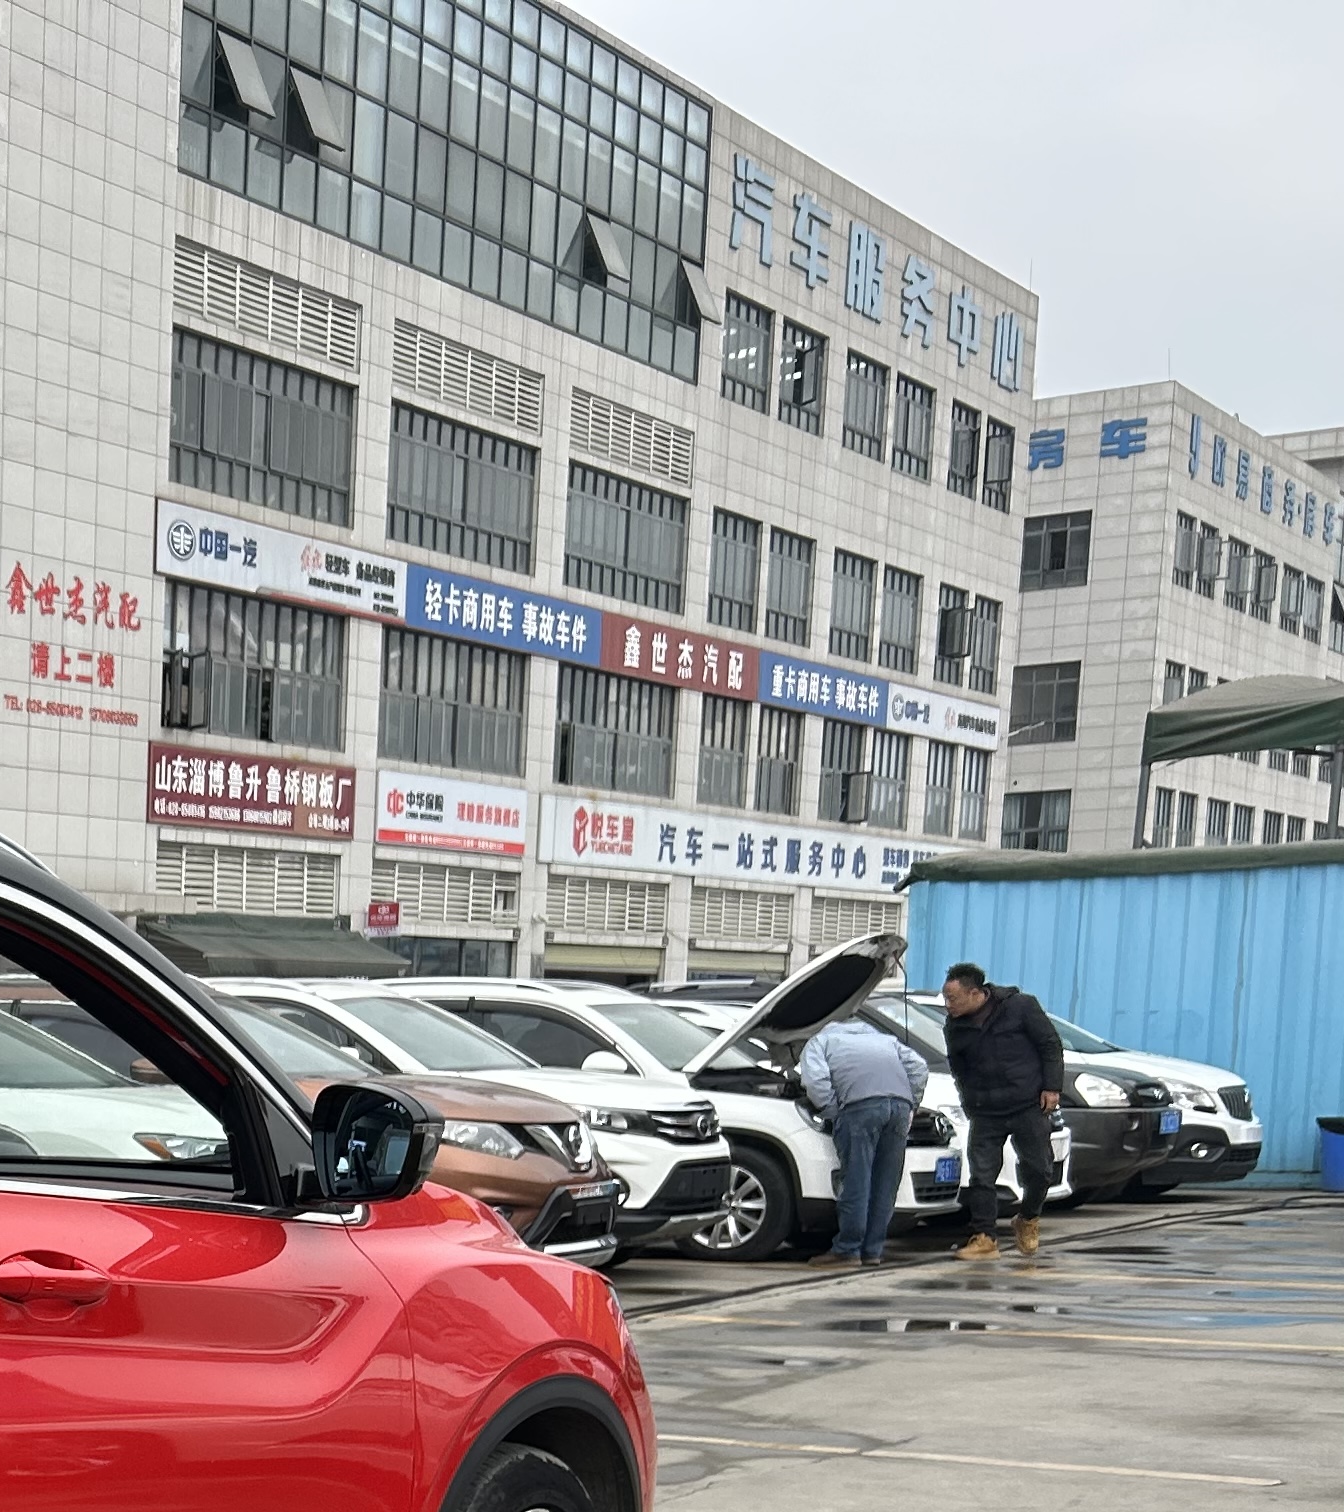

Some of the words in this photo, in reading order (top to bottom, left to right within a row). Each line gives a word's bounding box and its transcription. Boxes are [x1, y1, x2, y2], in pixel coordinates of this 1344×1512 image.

[729, 152, 1024, 393] 汽车服务中心
[5, 561, 141, 632] 鑫世杰汽配
[424, 578, 513, 637] 轻卡商用车
[522, 601, 587, 654] 事故车件
[623, 623, 744, 691] 鑫世杰汽配
[771, 664, 831, 707] 重卡商用车
[834, 677, 879, 717] 事故车件
[657, 823, 868, 881] 汽车一站式服务中心
